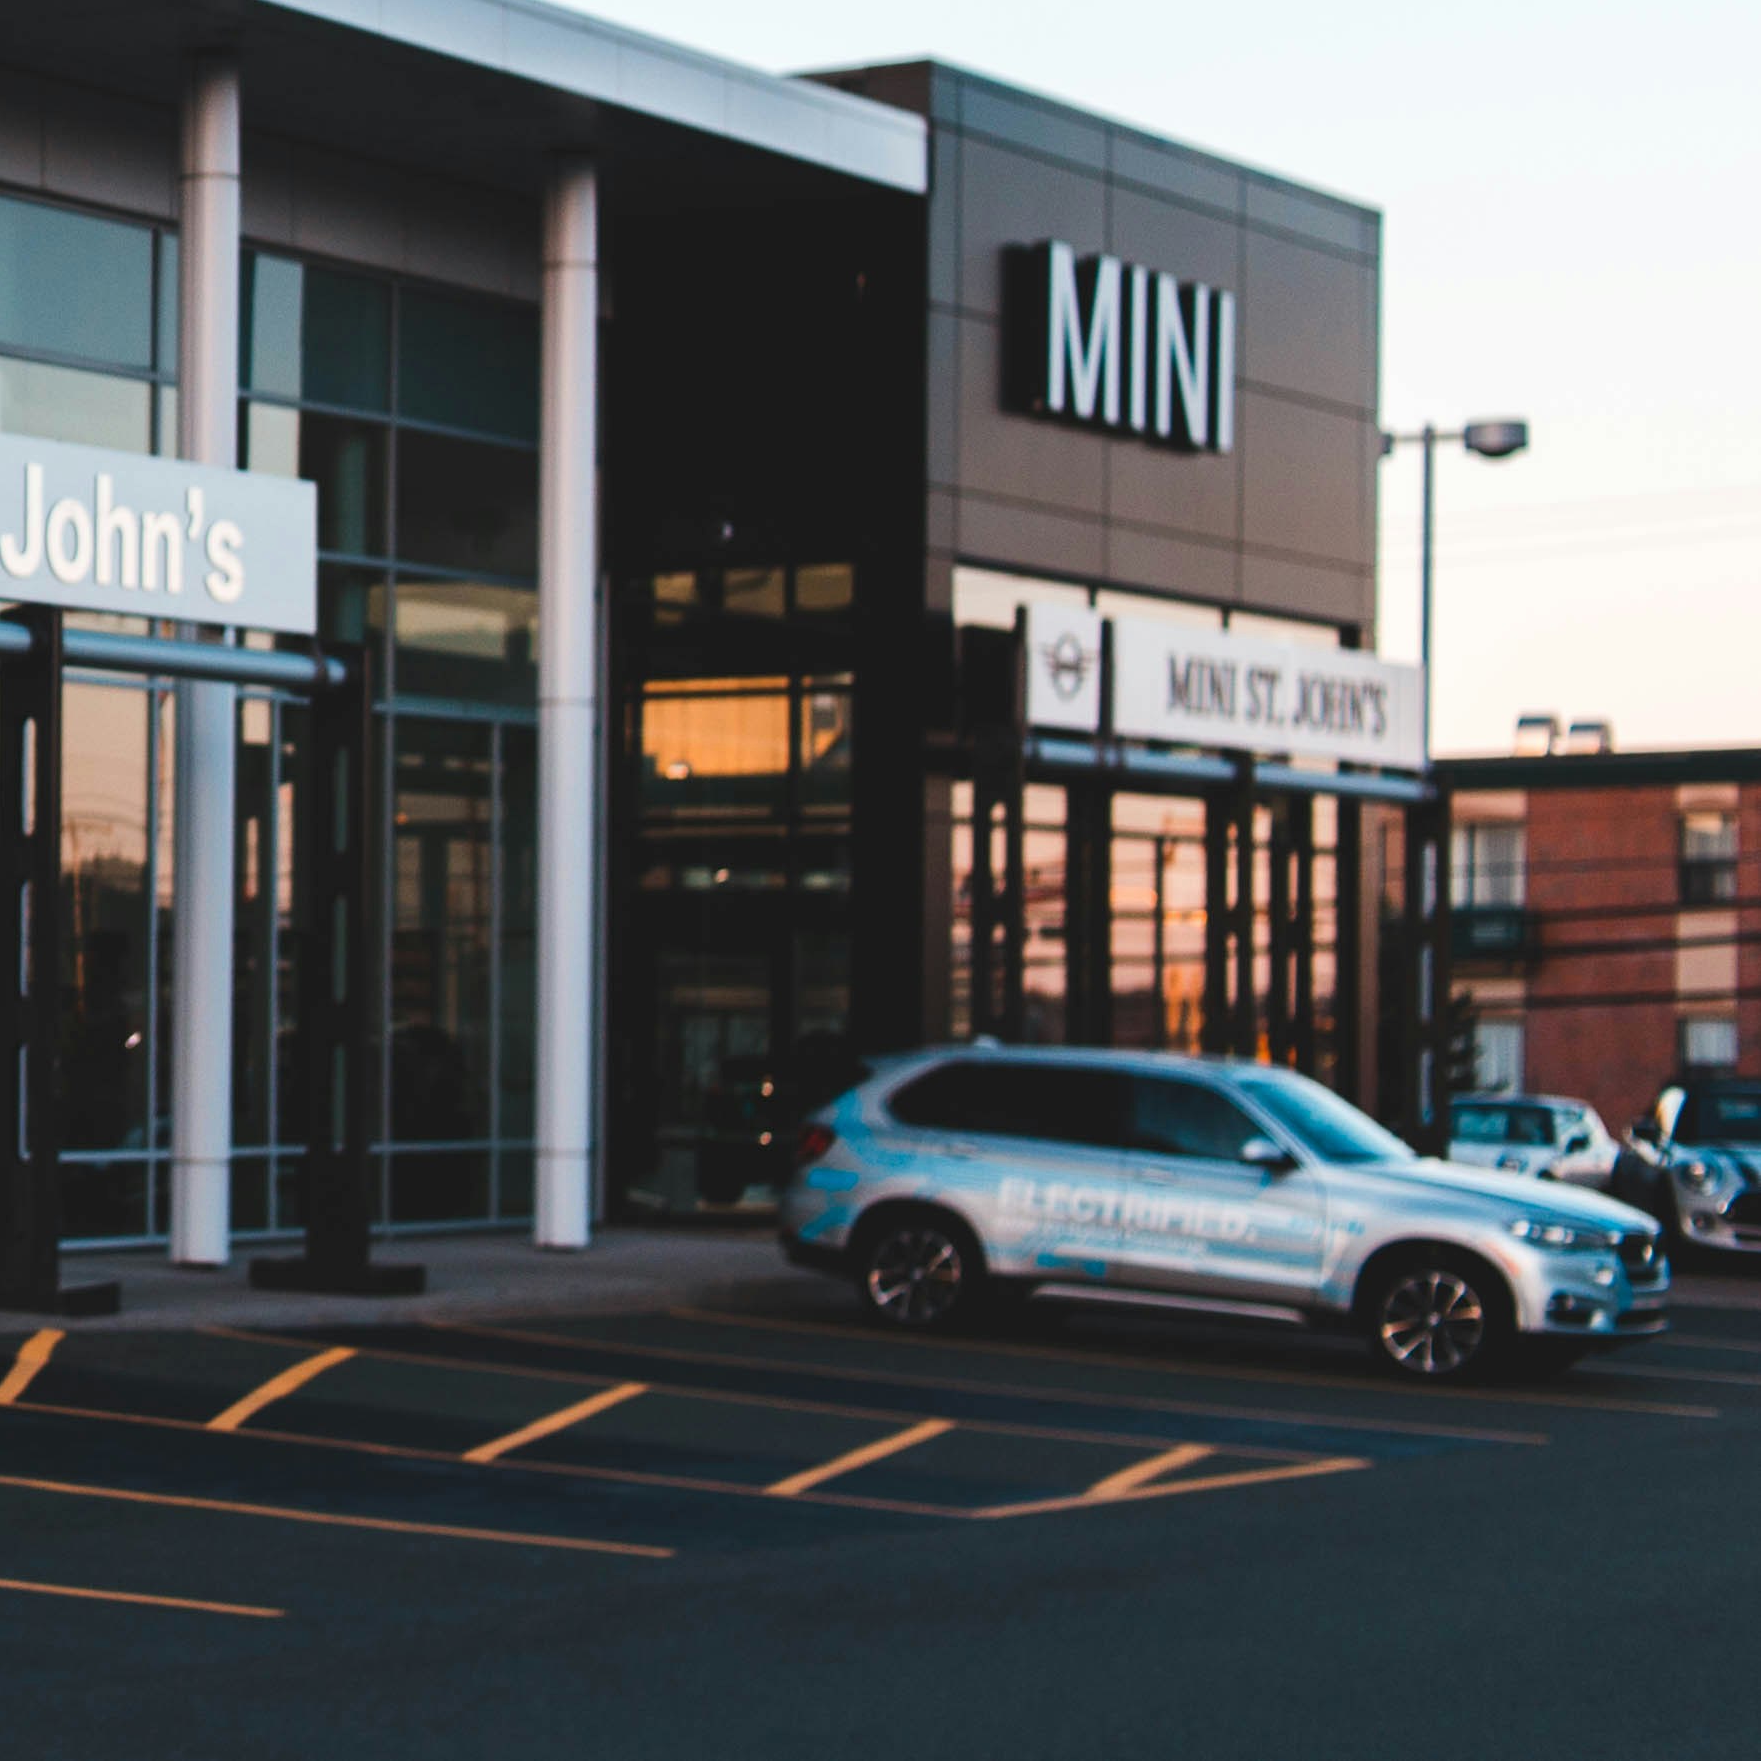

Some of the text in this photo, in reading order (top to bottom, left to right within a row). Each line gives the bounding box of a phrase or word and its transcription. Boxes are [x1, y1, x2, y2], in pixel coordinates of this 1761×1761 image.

[1047, 239, 1236, 453] MINI
[1167, 651, 1389, 738] MINI ST. JOHN'S
